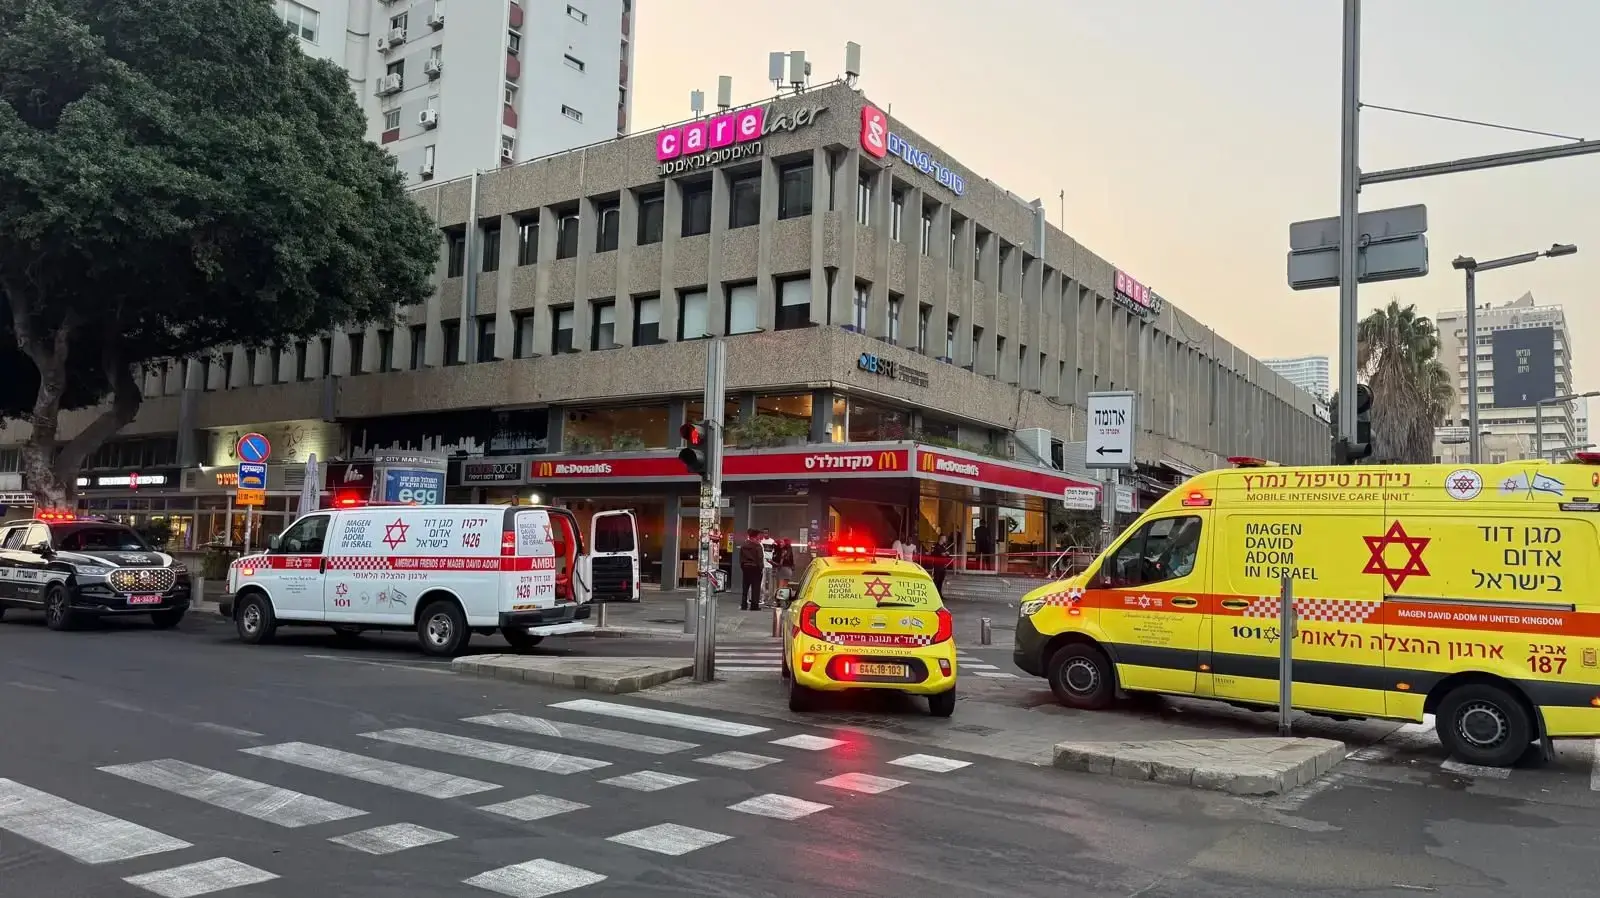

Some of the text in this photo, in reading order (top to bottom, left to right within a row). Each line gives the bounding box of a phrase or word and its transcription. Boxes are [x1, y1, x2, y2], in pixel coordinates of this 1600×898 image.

[661, 103, 829, 153] care laser
[711, 148, 731, 164] טוב
[657, 162, 675, 176] טוב
[675, 155, 705, 171] נראים
[887, 131, 965, 196] סופר-פארם
[1094, 408, 1126, 426] ארומה
[555, 463, 612, 474] McDonald's
[804, 454, 874, 470] מקדונלד'ס
[936, 458, 979, 476] McDonald's
[1243, 471, 1411, 492] ניידת טיפול נמרץ
[398, 488, 437, 504] egg
[1246, 492, 1410, 501] MOBILE INTENSIVE CARE UNIT
[346, 519, 372, 527] MAGEN
[423, 518, 454, 529] מגן דוד
[461, 518, 488, 529] ירקון
[1246, 523, 1302, 536] MAGEN
[344, 526, 365, 534] DAVID
[429, 528, 451, 538] אדום
[1477, 526, 1562, 546] מגן דוד
[343, 533, 364, 541] ADOM
[416, 537, 449, 548] בישראל
[461, 532, 481, 549] 1426
[1245, 536, 1294, 549] DAVID
[394, 558, 499, 569] AMERICAN FRIENDS OF MAGEN DAVID ADOM
[531, 558, 556, 569] AMBU
[1245, 550, 1294, 564] ADOM
[1504, 548, 1562, 567] אדום
[353, 571, 428, 581] ארגון ההצלה הלאומי
[1244, 565, 1319, 580] IN ISRAEL
[896, 580, 910, 588] דוד
[1471, 568, 1562, 592] בישראל
[516, 584, 553, 599] ירקון 1426
[906, 588, 928, 597] אדום
[334, 598, 351, 607] 101
[895, 593, 928, 604] בישראל
[829, 616, 849, 626] 101
[1398, 609, 1563, 626] MAGEN DAVID ADOM IN UNITED KINGDOM
[840, 634, 866, 642] מיידית
[1230, 625, 1261, 639] 101
[869, 635, 891, 643] תגובה
[1297, 629, 1504, 660] ארגון ההצלה הלאומ
[810, 644, 835, 652] 6314
[1529, 643, 1567, 655] אביב
[1527, 655, 1567, 675] 187
